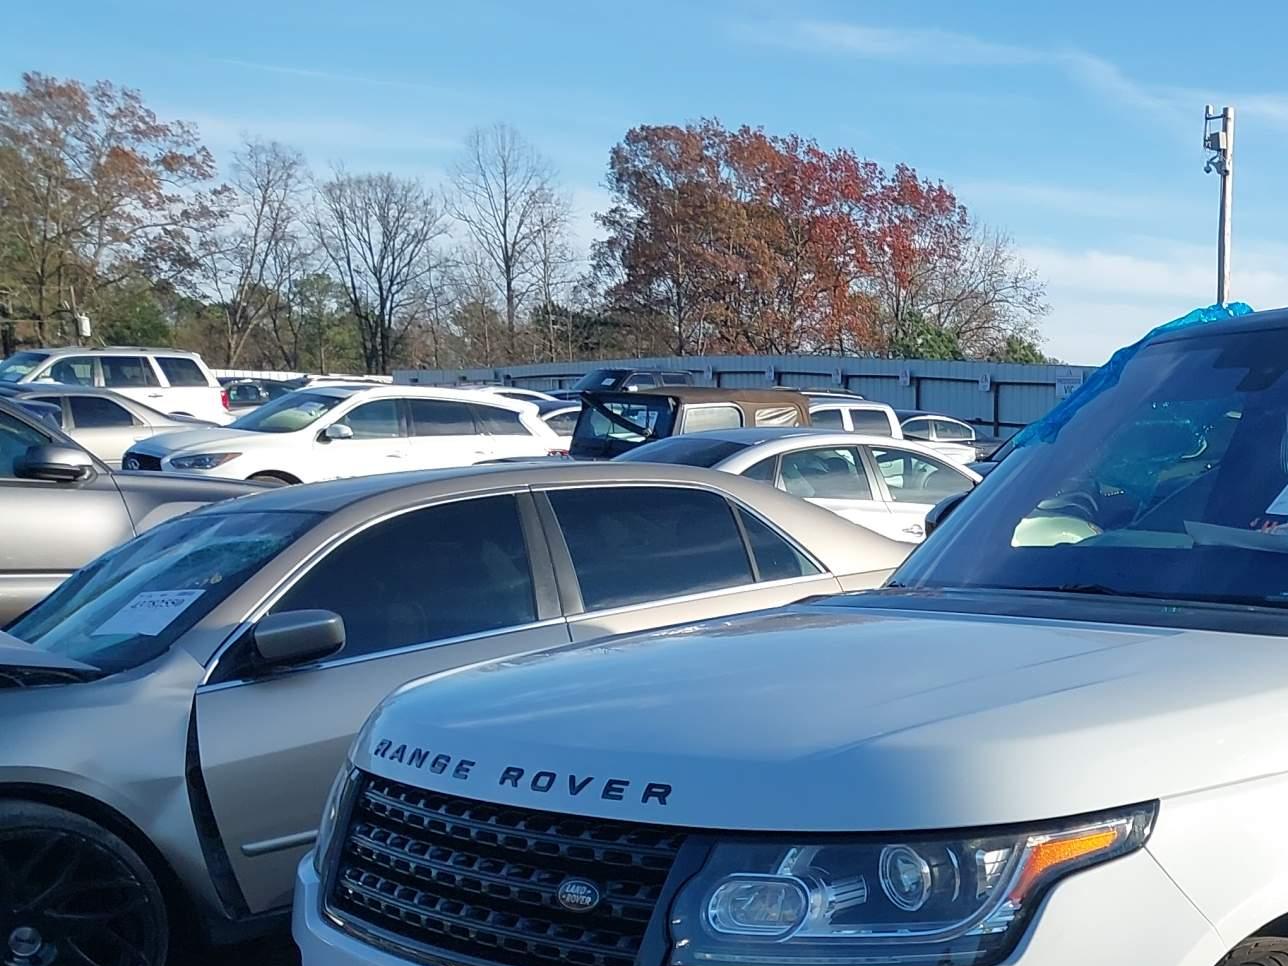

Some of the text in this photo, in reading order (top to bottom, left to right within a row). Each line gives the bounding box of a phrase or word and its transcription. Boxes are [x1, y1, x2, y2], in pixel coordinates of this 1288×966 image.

[373, 738, 673, 806] RANGE ROVER
[565, 884, 587, 895] LAND
[565, 893, 592, 905] ROVER
